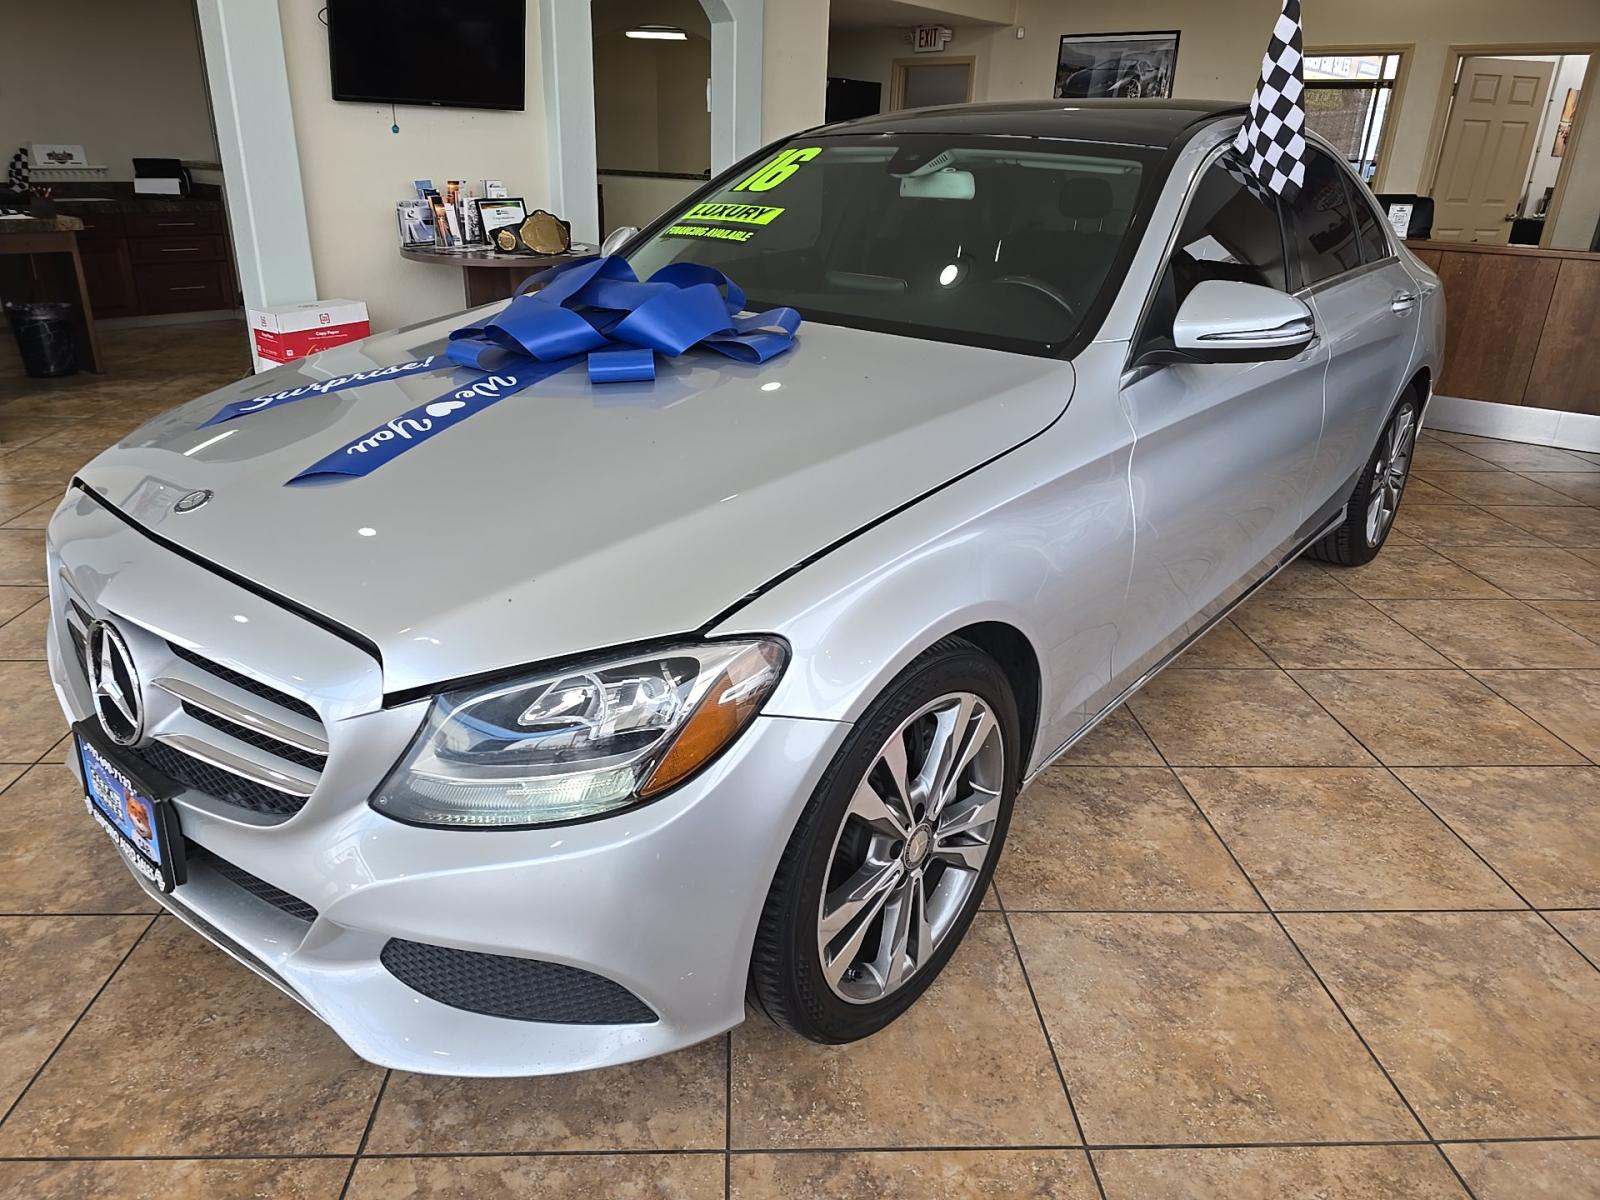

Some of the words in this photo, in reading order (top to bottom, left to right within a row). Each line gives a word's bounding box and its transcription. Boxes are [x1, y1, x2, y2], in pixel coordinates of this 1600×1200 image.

[918, 27, 938, 48] EXIT
[731, 146, 824, 192] 16
[689, 203, 774, 220] LUXURY
[703, 227, 755, 242] AVAILABLE
[240, 355, 435, 411] Surprise!
[455, 375, 517, 397] We
[347, 417, 433, 455] You
